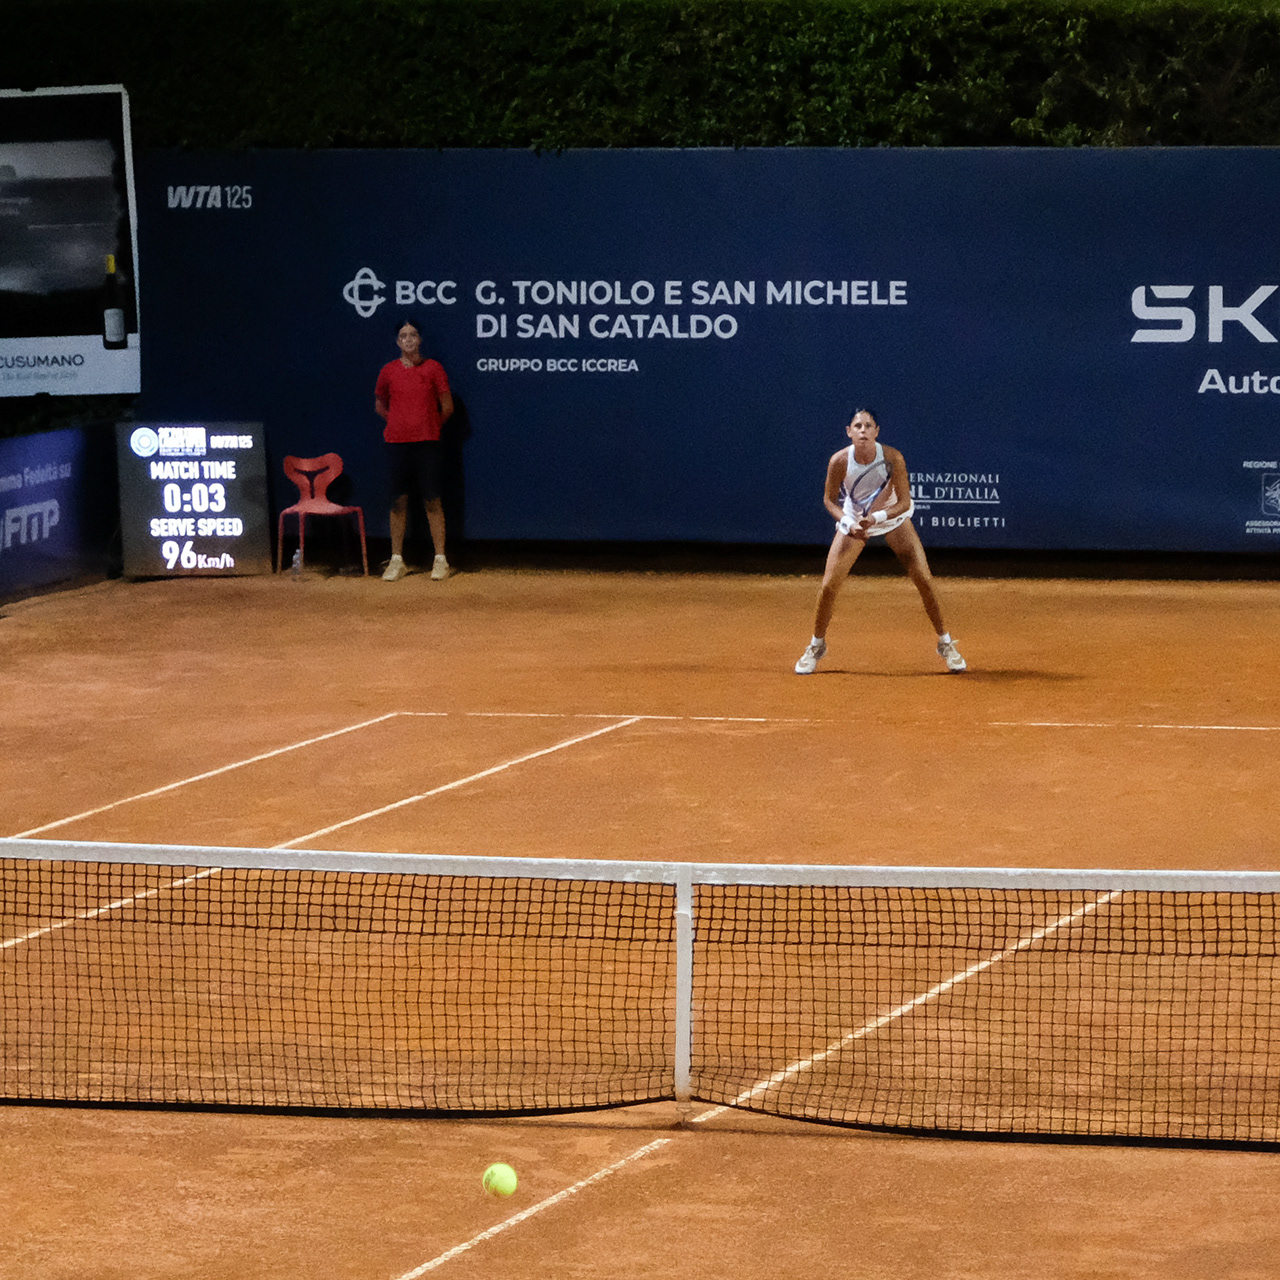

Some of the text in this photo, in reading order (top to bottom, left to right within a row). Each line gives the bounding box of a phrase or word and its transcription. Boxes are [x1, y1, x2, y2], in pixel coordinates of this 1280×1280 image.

[167, 185, 253, 209] WTA 125
[395, 280, 908, 306] BCC G. TONIOLO E SAN MICHELE
[476, 313, 738, 340] DI SAN CATALDO
[476, 358, 639, 372] GRUPPO BCC ICCREA
[150, 460, 237, 480] MATCH TIME
[1242, 460, 1278, 469] REGIONE
[163, 483, 227, 513] 0:03
[934, 486, 1000, 500] D'ITALIA
[150, 517, 244, 537] SERVE SPEED
[931, 516, 1006, 528] BIGLIETTI
